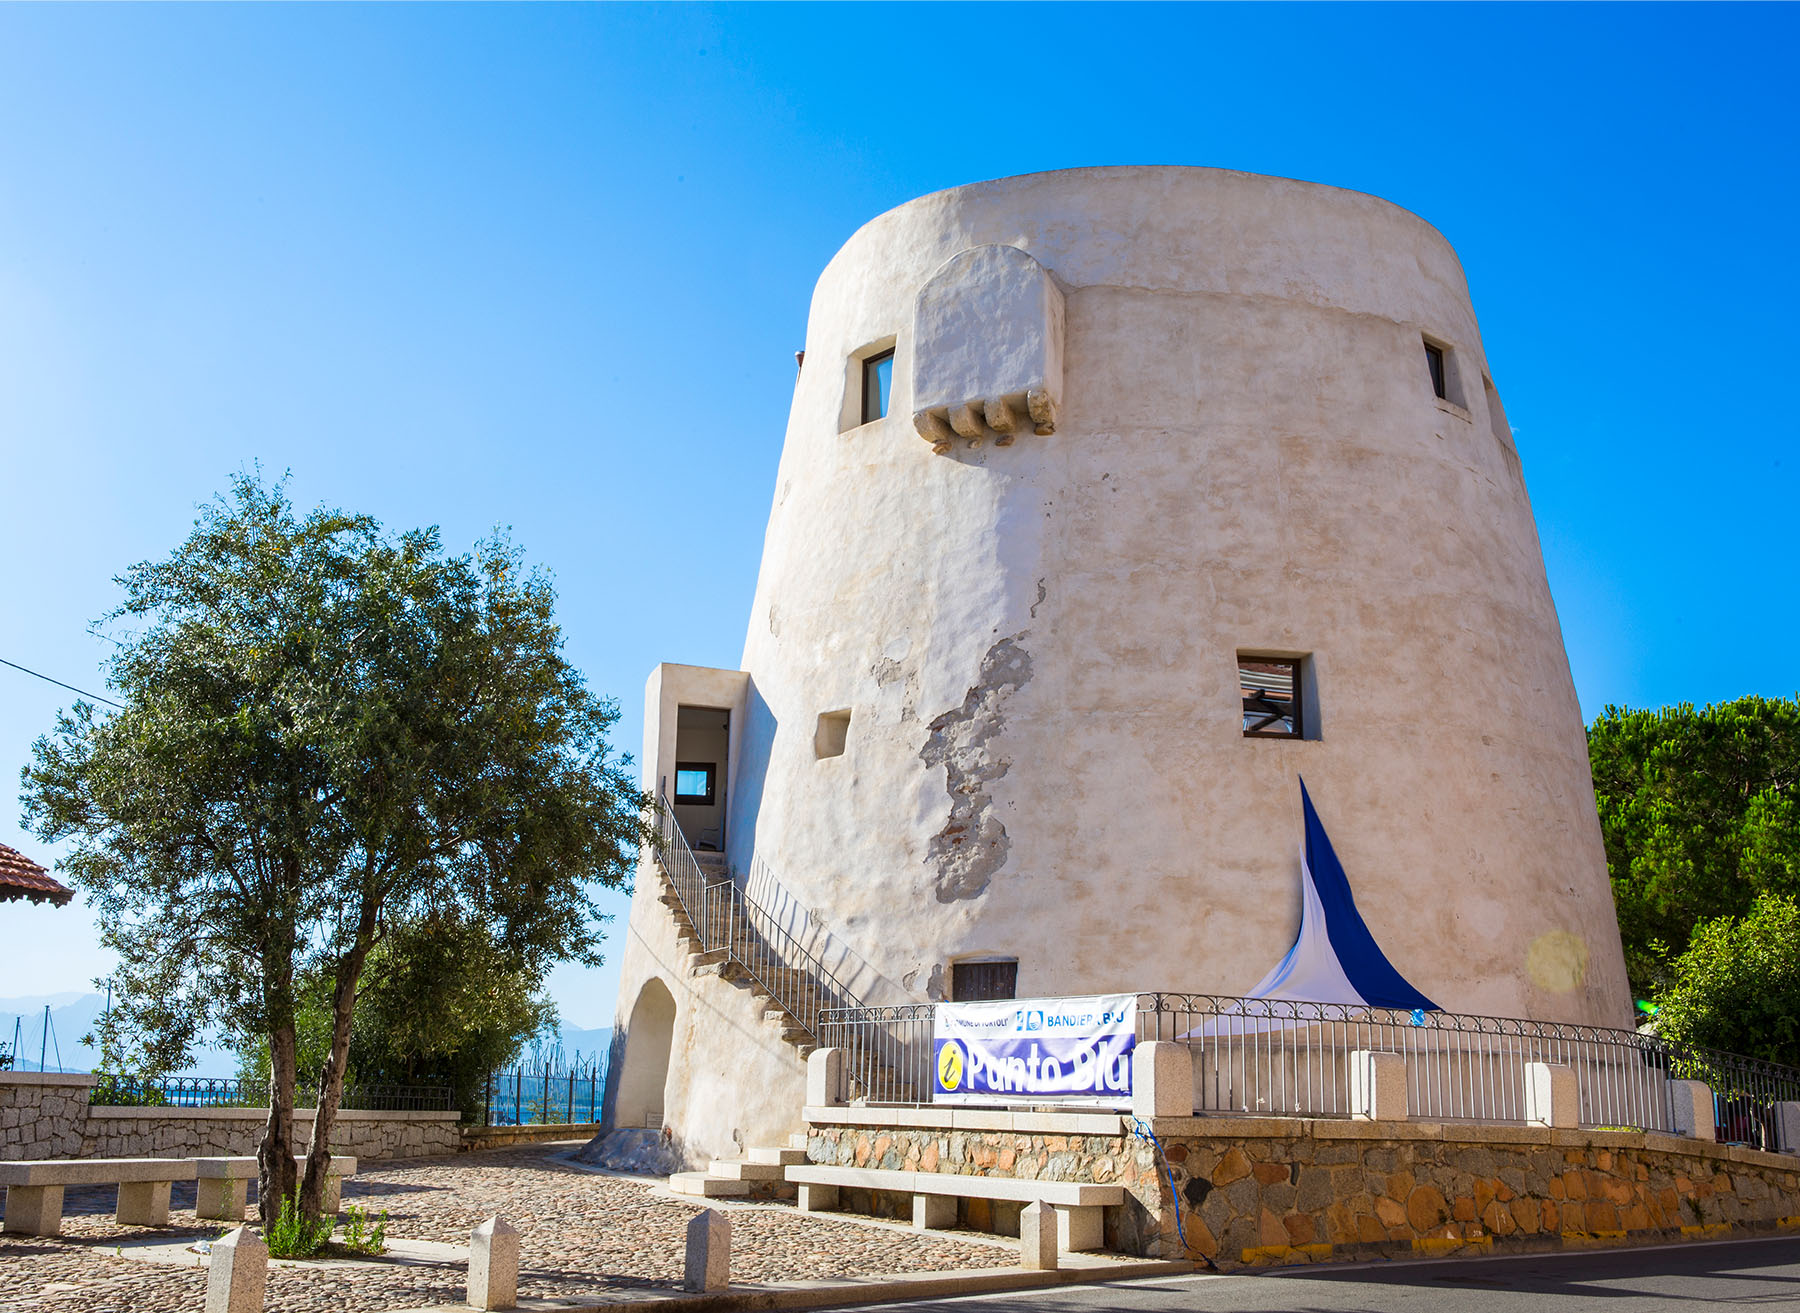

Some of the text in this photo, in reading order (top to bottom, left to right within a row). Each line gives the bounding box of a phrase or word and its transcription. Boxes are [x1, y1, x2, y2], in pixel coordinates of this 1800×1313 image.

[1047, 1014, 1100, 1027] BANDIER
[967, 1040, 1130, 1093] Punto Blu
